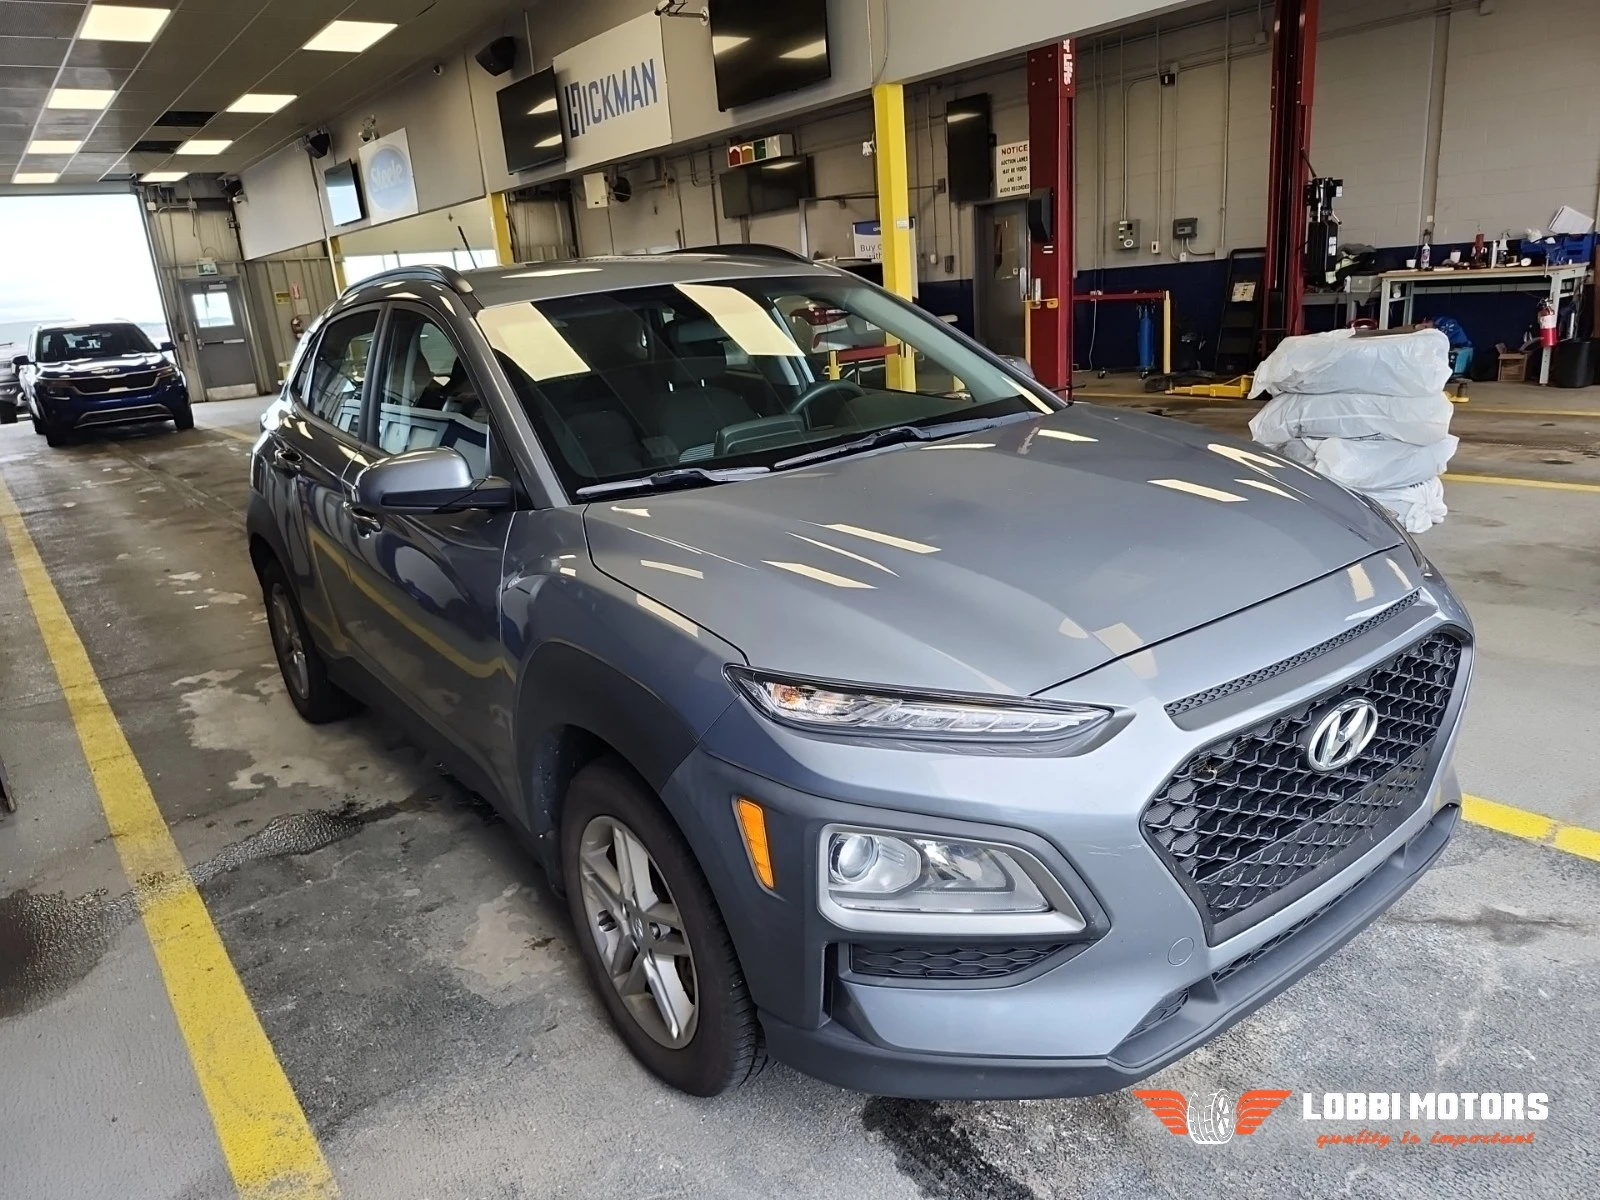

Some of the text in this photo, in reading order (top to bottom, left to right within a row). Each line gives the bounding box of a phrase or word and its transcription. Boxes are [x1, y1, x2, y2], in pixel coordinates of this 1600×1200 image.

[565, 58, 658, 138] HICKMAN
[1001, 144, 1028, 156] NOTICE
[1001, 158, 1016, 166] AUCTION
[370, 159, 405, 193] Steele
[860, 244, 875, 253] Buy
